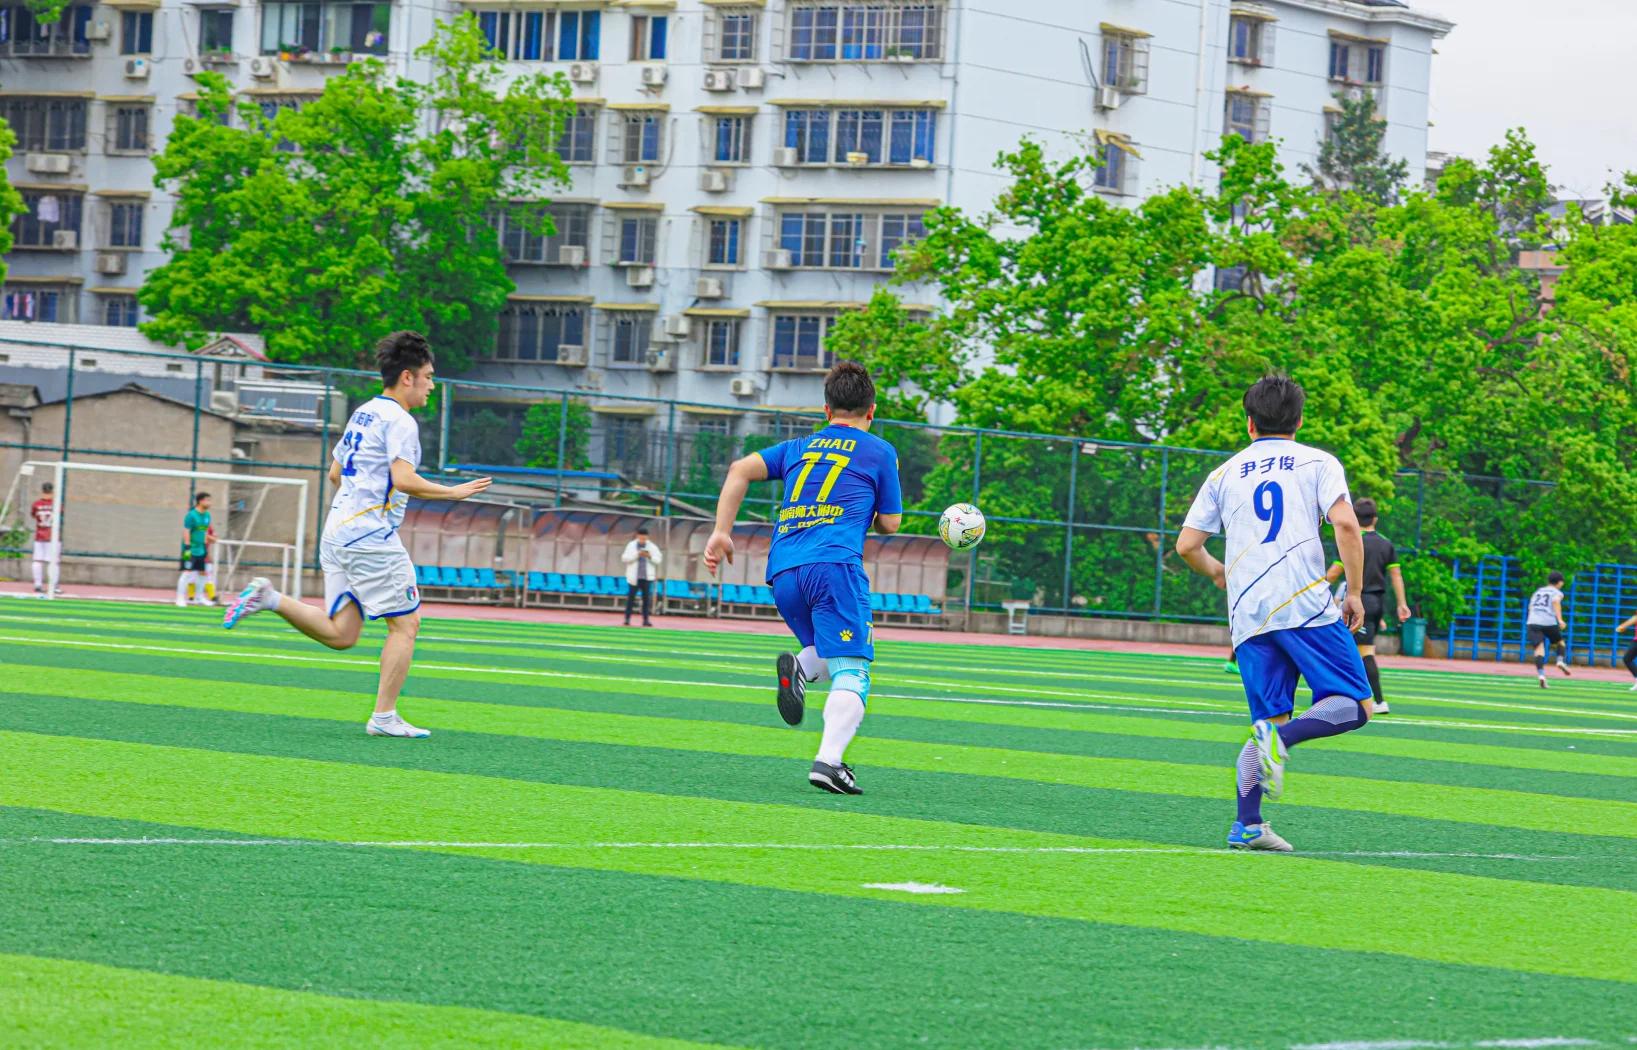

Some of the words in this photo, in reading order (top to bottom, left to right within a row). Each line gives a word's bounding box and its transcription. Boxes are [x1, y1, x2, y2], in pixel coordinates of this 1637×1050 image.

[807, 438, 857, 452] ZHAO
[789, 451, 851, 503] 77
[1240, 455, 1295, 478] 尹子俊
[1253, 479, 1284, 545] 9
